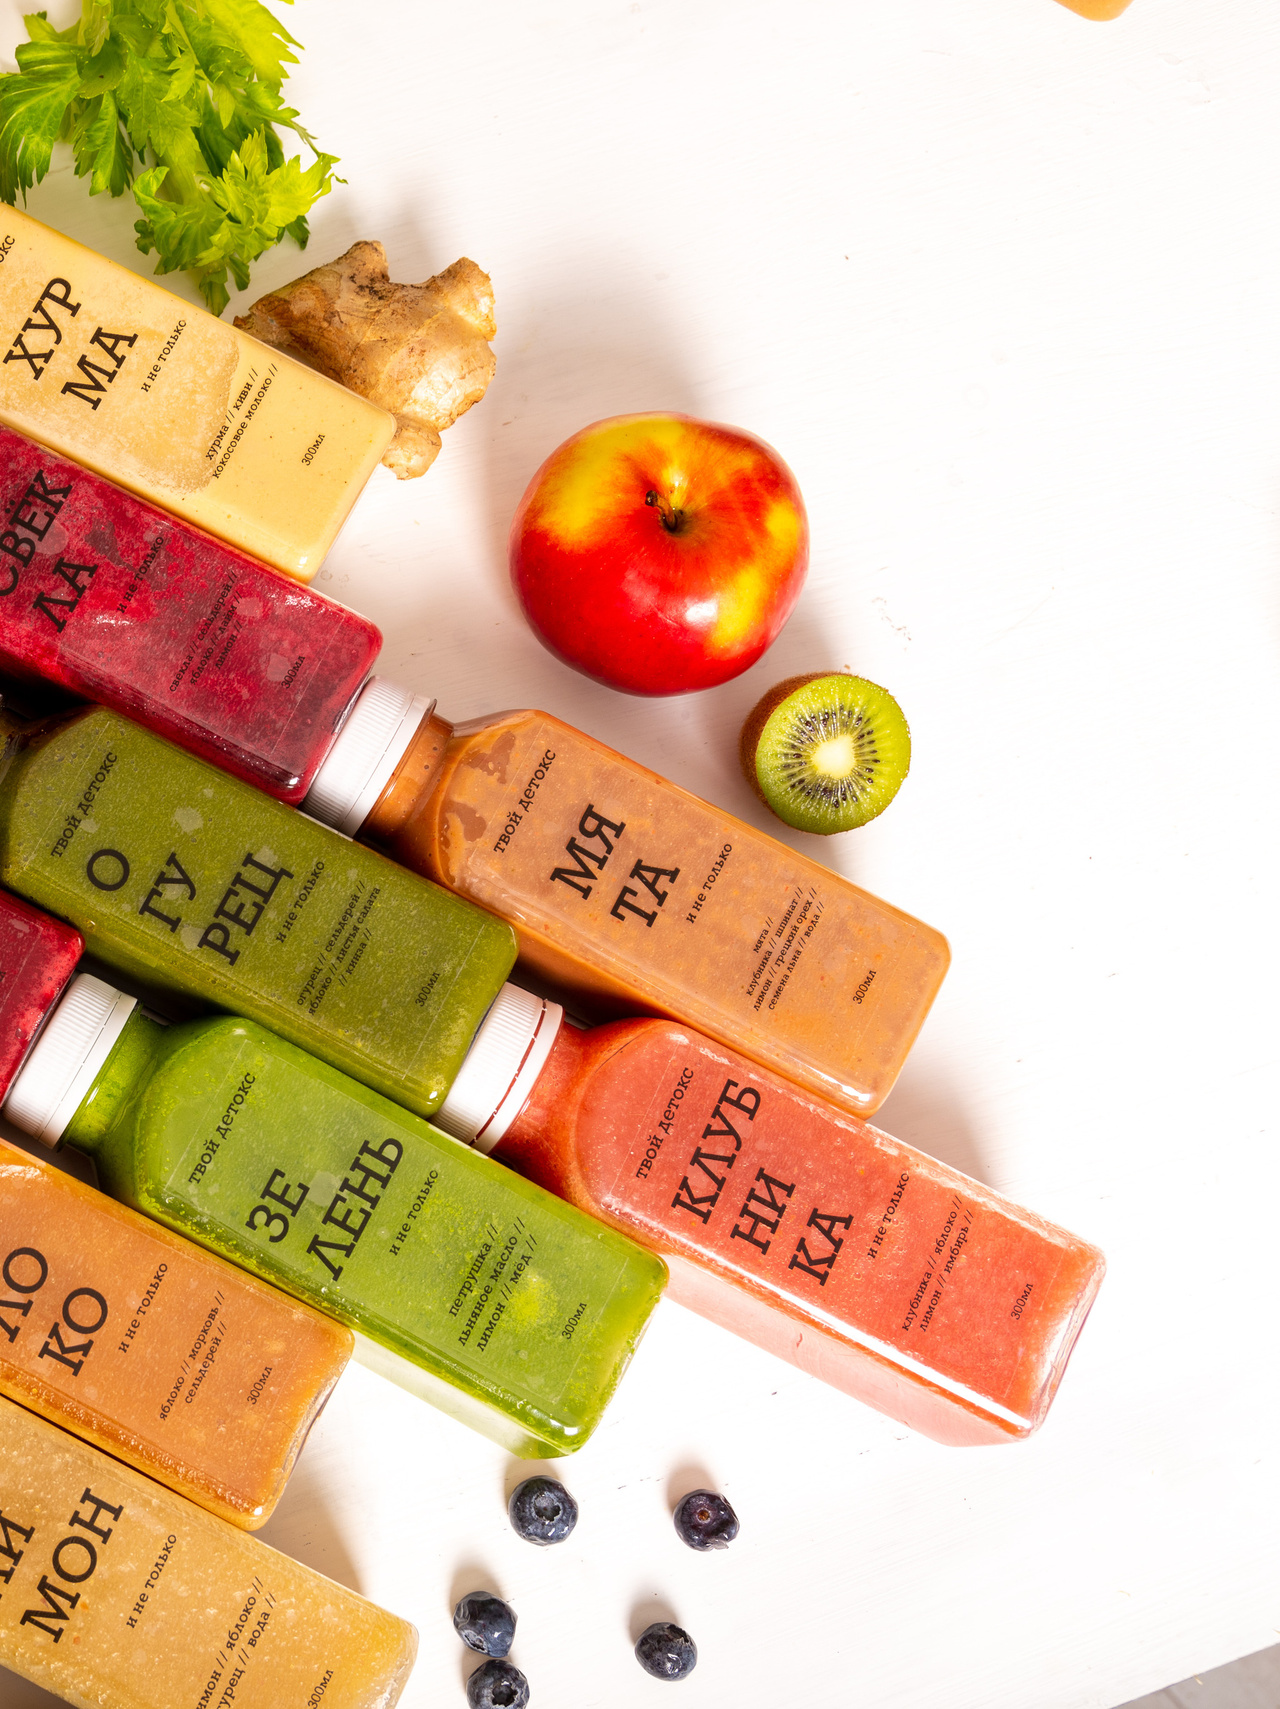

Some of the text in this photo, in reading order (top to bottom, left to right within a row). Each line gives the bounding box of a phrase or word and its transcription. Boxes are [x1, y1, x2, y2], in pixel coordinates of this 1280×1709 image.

[1, 277, 82, 382] ХУР
[59, 326, 139, 412] МА
[140, 319, 188, 393] и не только
[204, 381, 254, 462] хурма киви
[211, 377, 273, 480] кокосовое молоко
[300, 433, 326, 467] 300мл
[31, 556, 100, 634] ЛА
[116, 602, 128, 615] и
[122, 582, 139, 603] не
[49, 751, 119, 858] твой детокс
[492, 748, 557, 854] твой детокс
[85, 847, 131, 893] О
[138, 851, 197, 934] ГУ
[548, 803, 627, 901] МЯ
[609, 858, 681, 929] ТА
[685, 842, 733, 925] и не только
[196, 851, 295, 967] РЕЦ
[275, 860, 326, 945] и не только
[752, 928, 770, 955] мята
[296, 893, 361, 1007] огурец сельдерей
[308, 887, 382, 1016] яблоко листья салата
[344, 941, 368, 976] кинза
[414, 971, 441, 1008] 300мл
[745, 898, 799, 997] клубника шпинат
[752, 899, 814, 1013] лимон грецкий орех
[767, 913, 821, 1011] семена льна вода
[851, 969, 878, 1005] 300мл
[187, 1071, 257, 1185] твой детокс
[635, 1066, 695, 1180] твой детокс
[670, 1078, 762, 1226] КЛУБ
[244, 1167, 311, 1244] ЗЕ
[305, 1137, 404, 1283] ЛЕНЬ
[388, 1169, 439, 1257] и не только
[729, 1166, 797, 1256] НИ
[787, 1206, 855, 1287] КА
[866, 1172, 910, 1260] и не только
[117, 1262, 169, 1354] и не только
[448, 1242, 493, 1318] петрушка
[457, 1235, 519, 1347] льняное масло
[901, 1210, 958, 1332] клубника яблоко
[919, 1226, 970, 1333] лимон имбирь
[1009, 1282, 1034, 1321] 300мл
[37, 1286, 109, 1378] КО
[158, 1306, 220, 1422] яблоко морковь
[476, 1301, 507, 1353] лимон
[560, 1301, 588, 1341] 300мл
[184, 1336, 223, 1405] сельдерей
[246, 1365, 274, 1406] 300мл
[18, 1486, 125, 1645] МОН
[125, 1533, 178, 1630] и не только
[197, 1595, 257, 1709] имон яблоко
[246, 1611, 271, 1649] вода
[306, 1669, 335, 1709] 300мл
